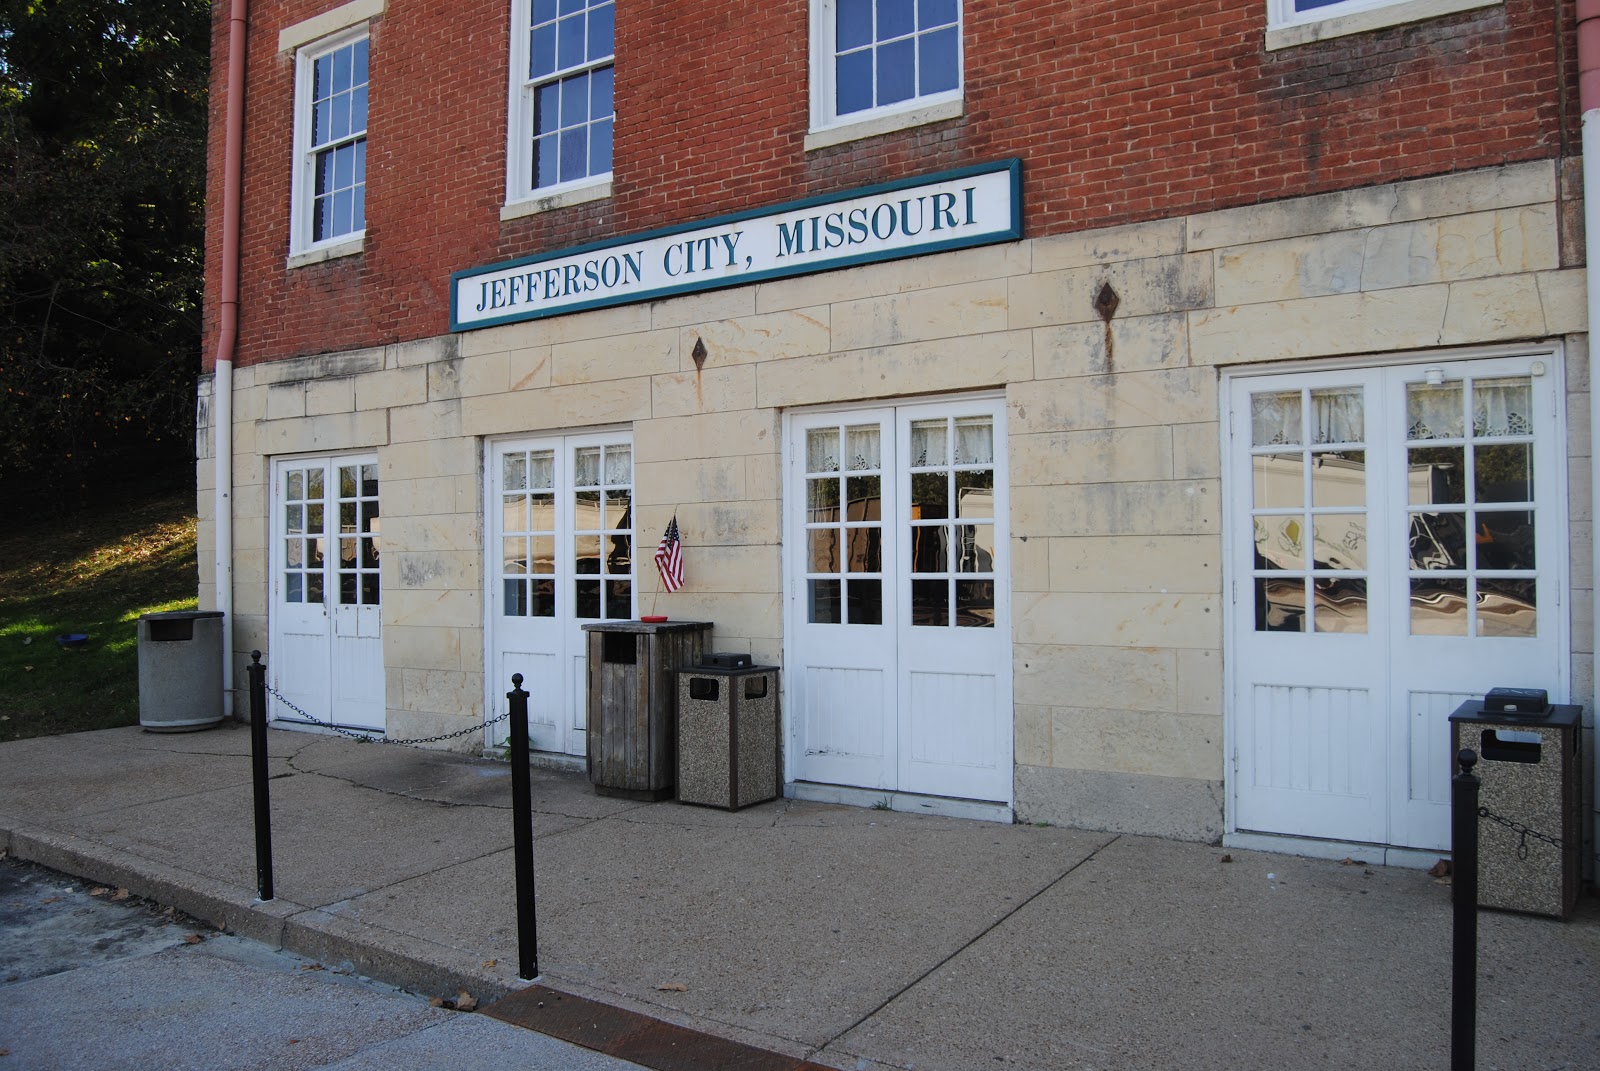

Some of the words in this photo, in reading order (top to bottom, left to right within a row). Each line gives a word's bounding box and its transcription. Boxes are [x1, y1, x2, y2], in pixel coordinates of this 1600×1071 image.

[476, 250, 644, 313] JEFFERSON
[663, 230, 753, 277] CITY,
[776, 186, 978, 258] MISSOURI
